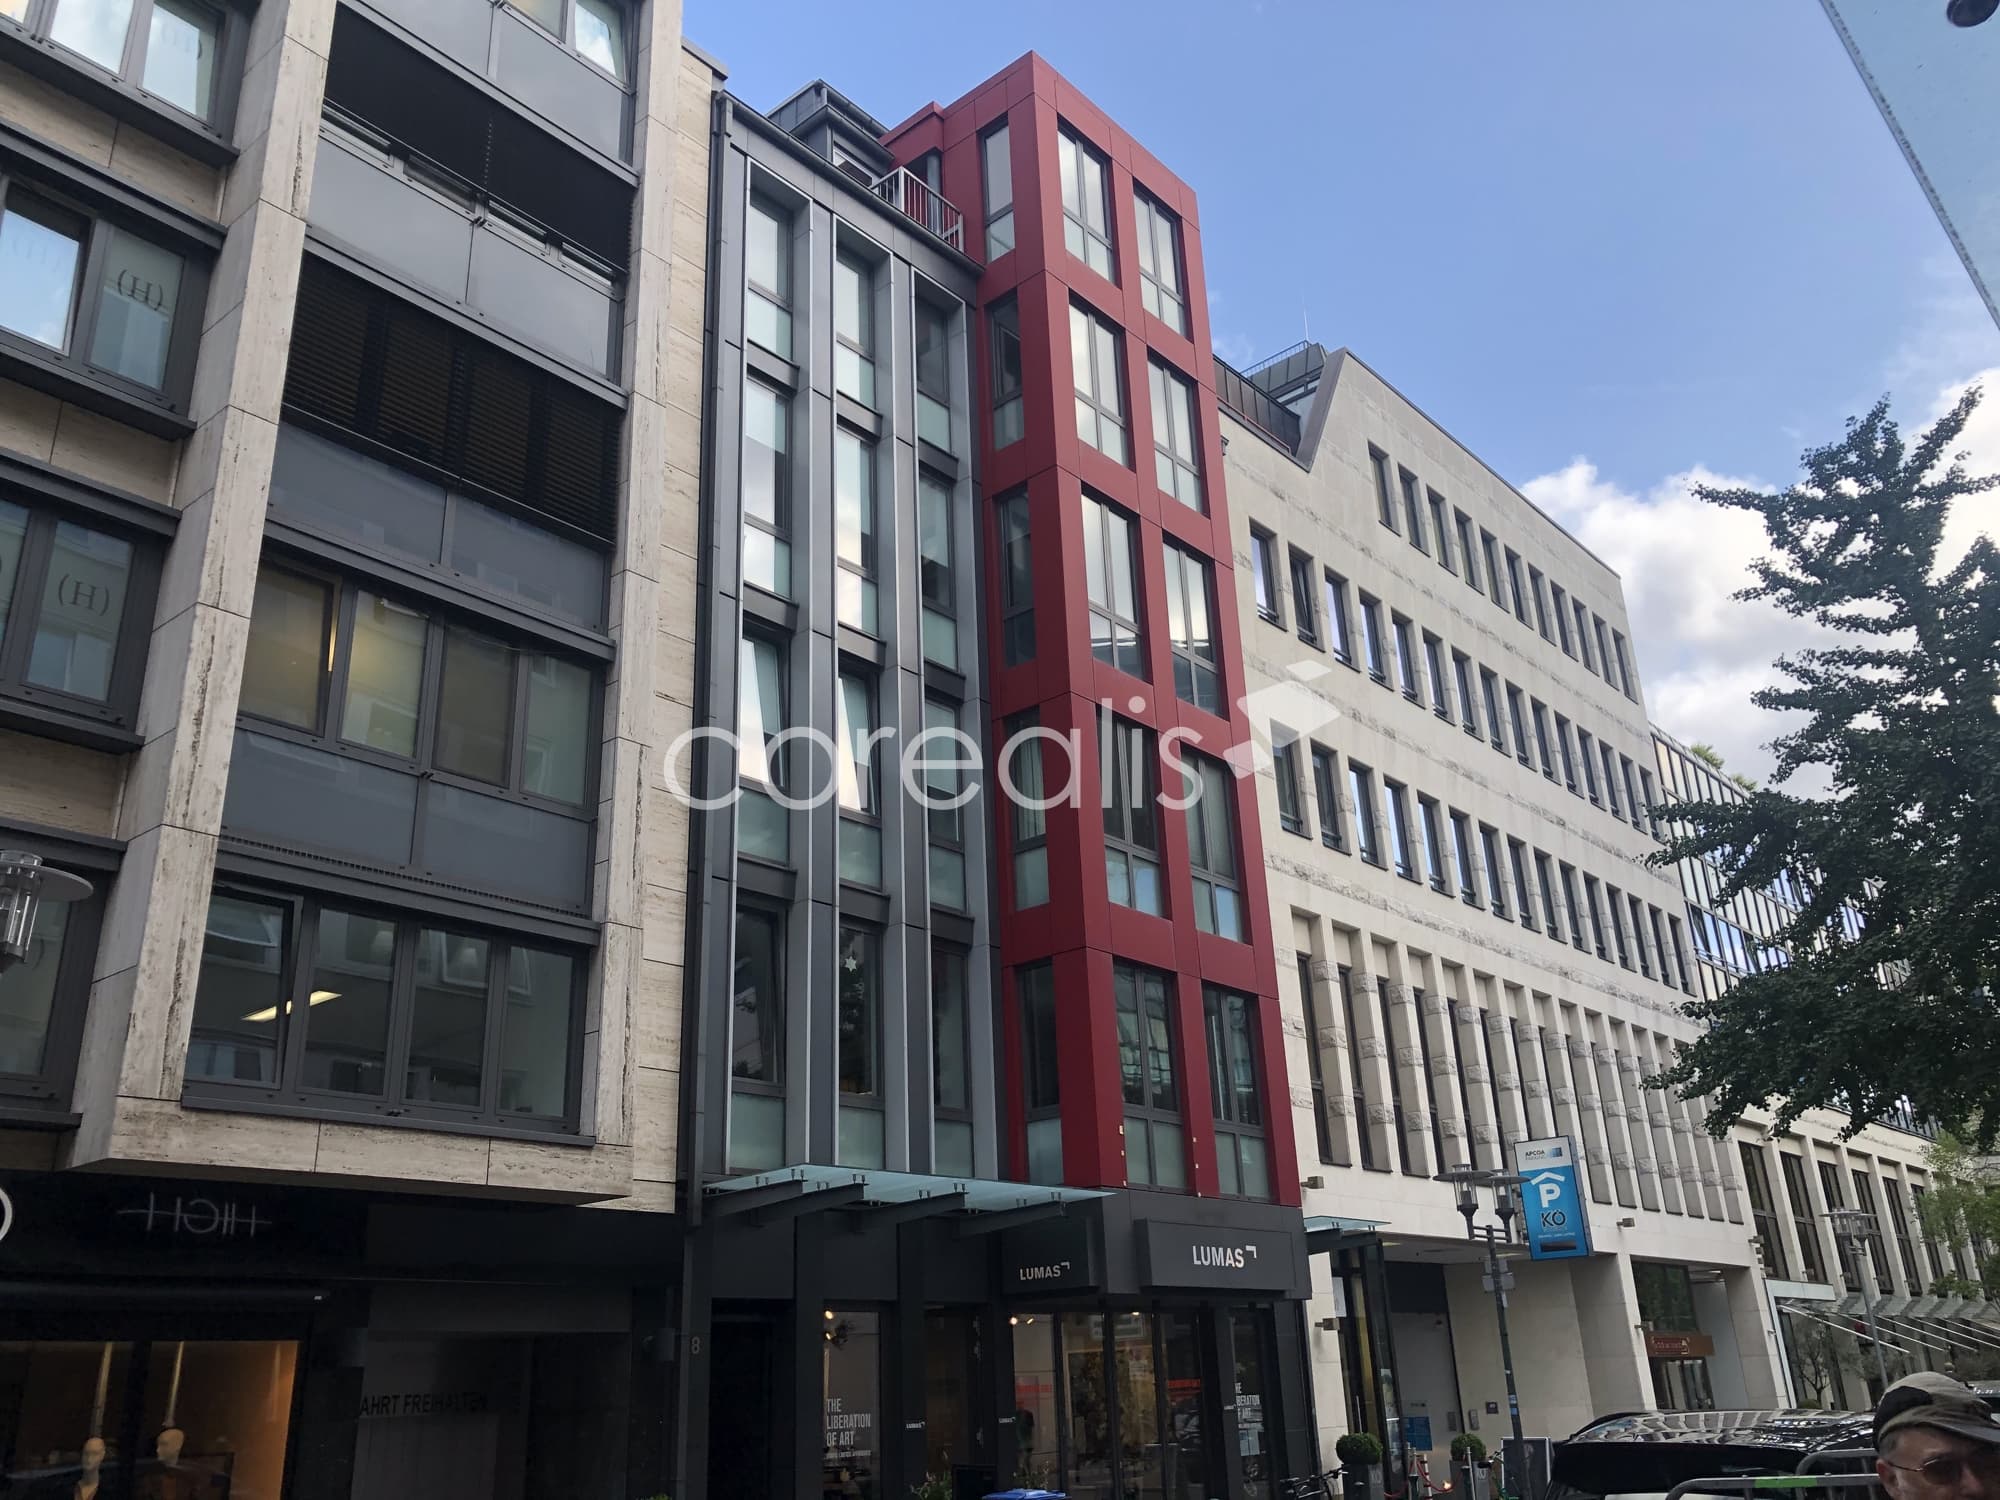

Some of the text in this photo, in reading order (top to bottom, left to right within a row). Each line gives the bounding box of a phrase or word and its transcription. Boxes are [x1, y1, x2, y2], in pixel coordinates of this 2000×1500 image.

[1538, 1183, 1561, 1208] P
[1192, 1245, 1245, 1269] LUMAS
[1020, 1265, 1062, 1281] LUMAS
[691, 1336, 700, 1355] 8
[826, 1398, 842, 1413] THE
[826, 1413, 872, 1430] LIBERATION
[826, 1430, 855, 1447] OF ART
